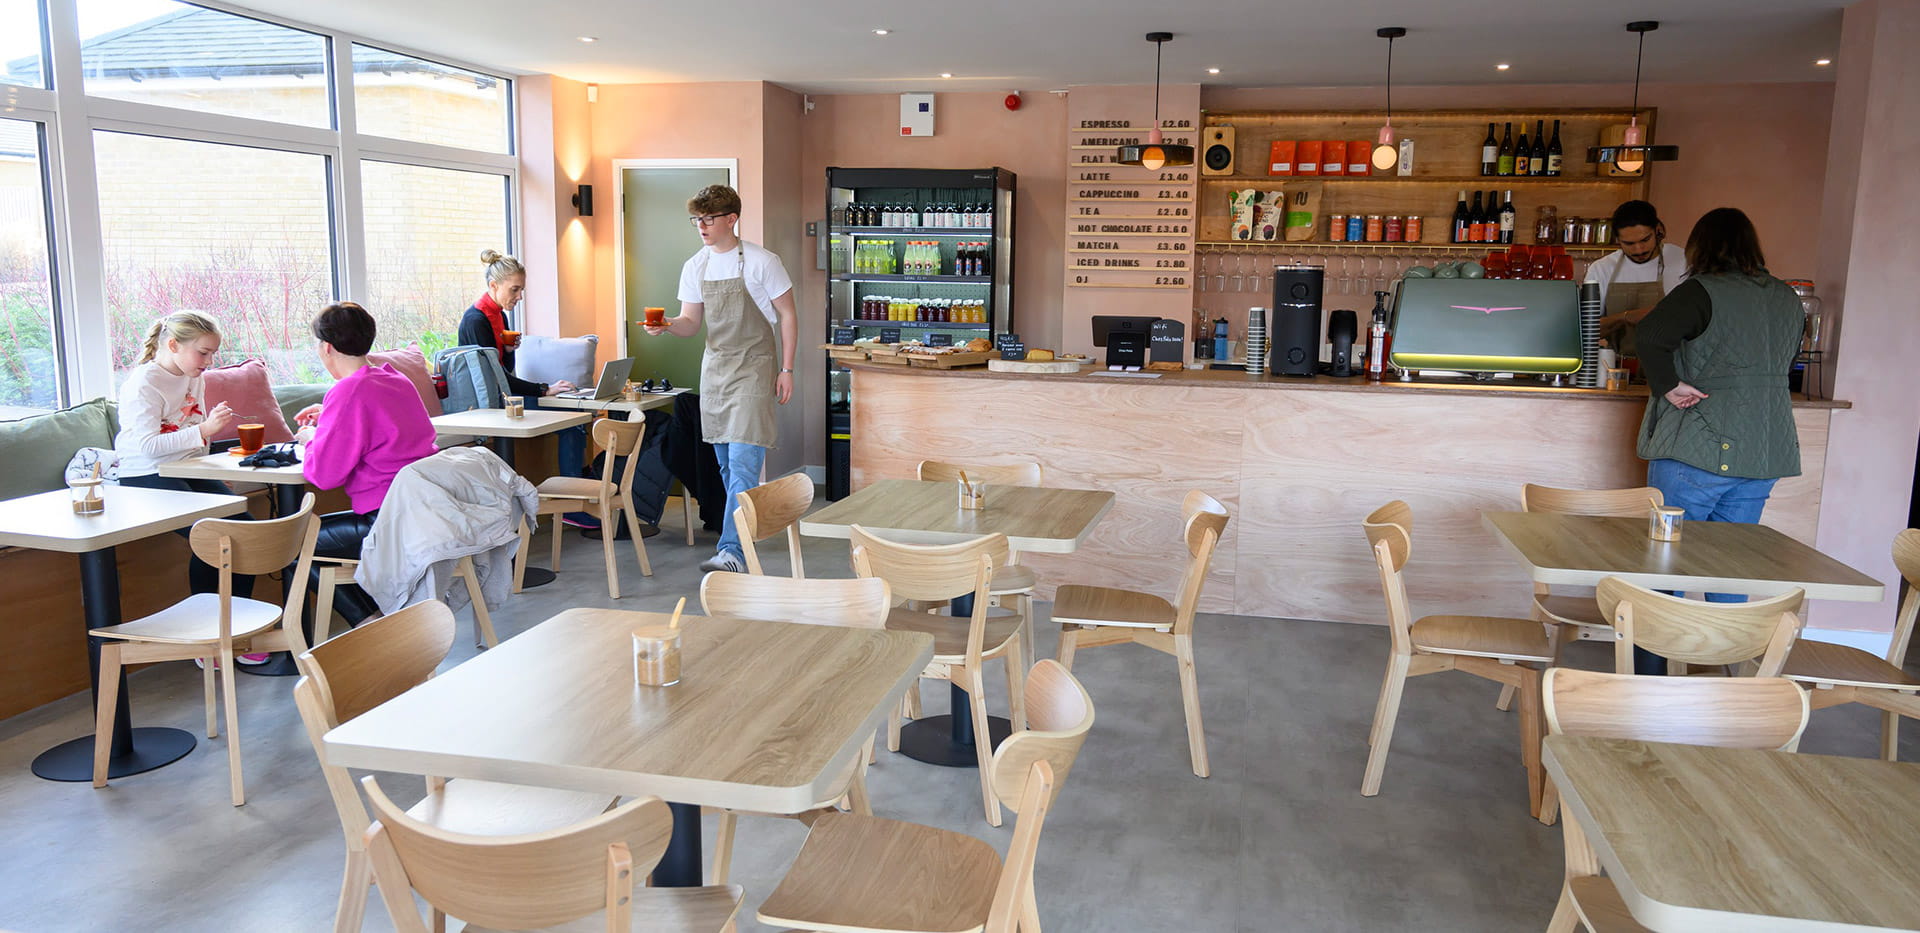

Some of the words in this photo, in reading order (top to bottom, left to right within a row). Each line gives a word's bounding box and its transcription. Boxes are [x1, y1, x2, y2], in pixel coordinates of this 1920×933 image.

[1081, 120, 1130, 129] ESPRESSO
[1162, 120, 1190, 128] £2.60
[1081, 138, 1139, 146] AMERICANO
[1081, 155, 1104, 163] FLAT
[1080, 173, 1110, 181] LATTE
[1160, 173, 1188, 181] £3.40
[1080, 190, 1139, 198] CAPPUCCINO
[1158, 190, 1188, 199] £3.40
[1079, 207, 1100, 215] TEA
[1157, 208, 1188, 216] £2.60
[1078, 225, 1097, 233] HOT
[1101, 225, 1152, 233] CHOCOLATE
[1157, 225, 1187, 233] £3.60
[1077, 242, 1119, 250] MATCHA
[1157, 243, 1186, 251] £3.60
[1076, 258, 1099, 266] ICED
[1105, 259, 1139, 267] DRINKS
[1156, 260, 1185, 268] £3.80
[1076, 276, 1088, 284] OJ
[1155, 277, 1185, 285] £2.60
